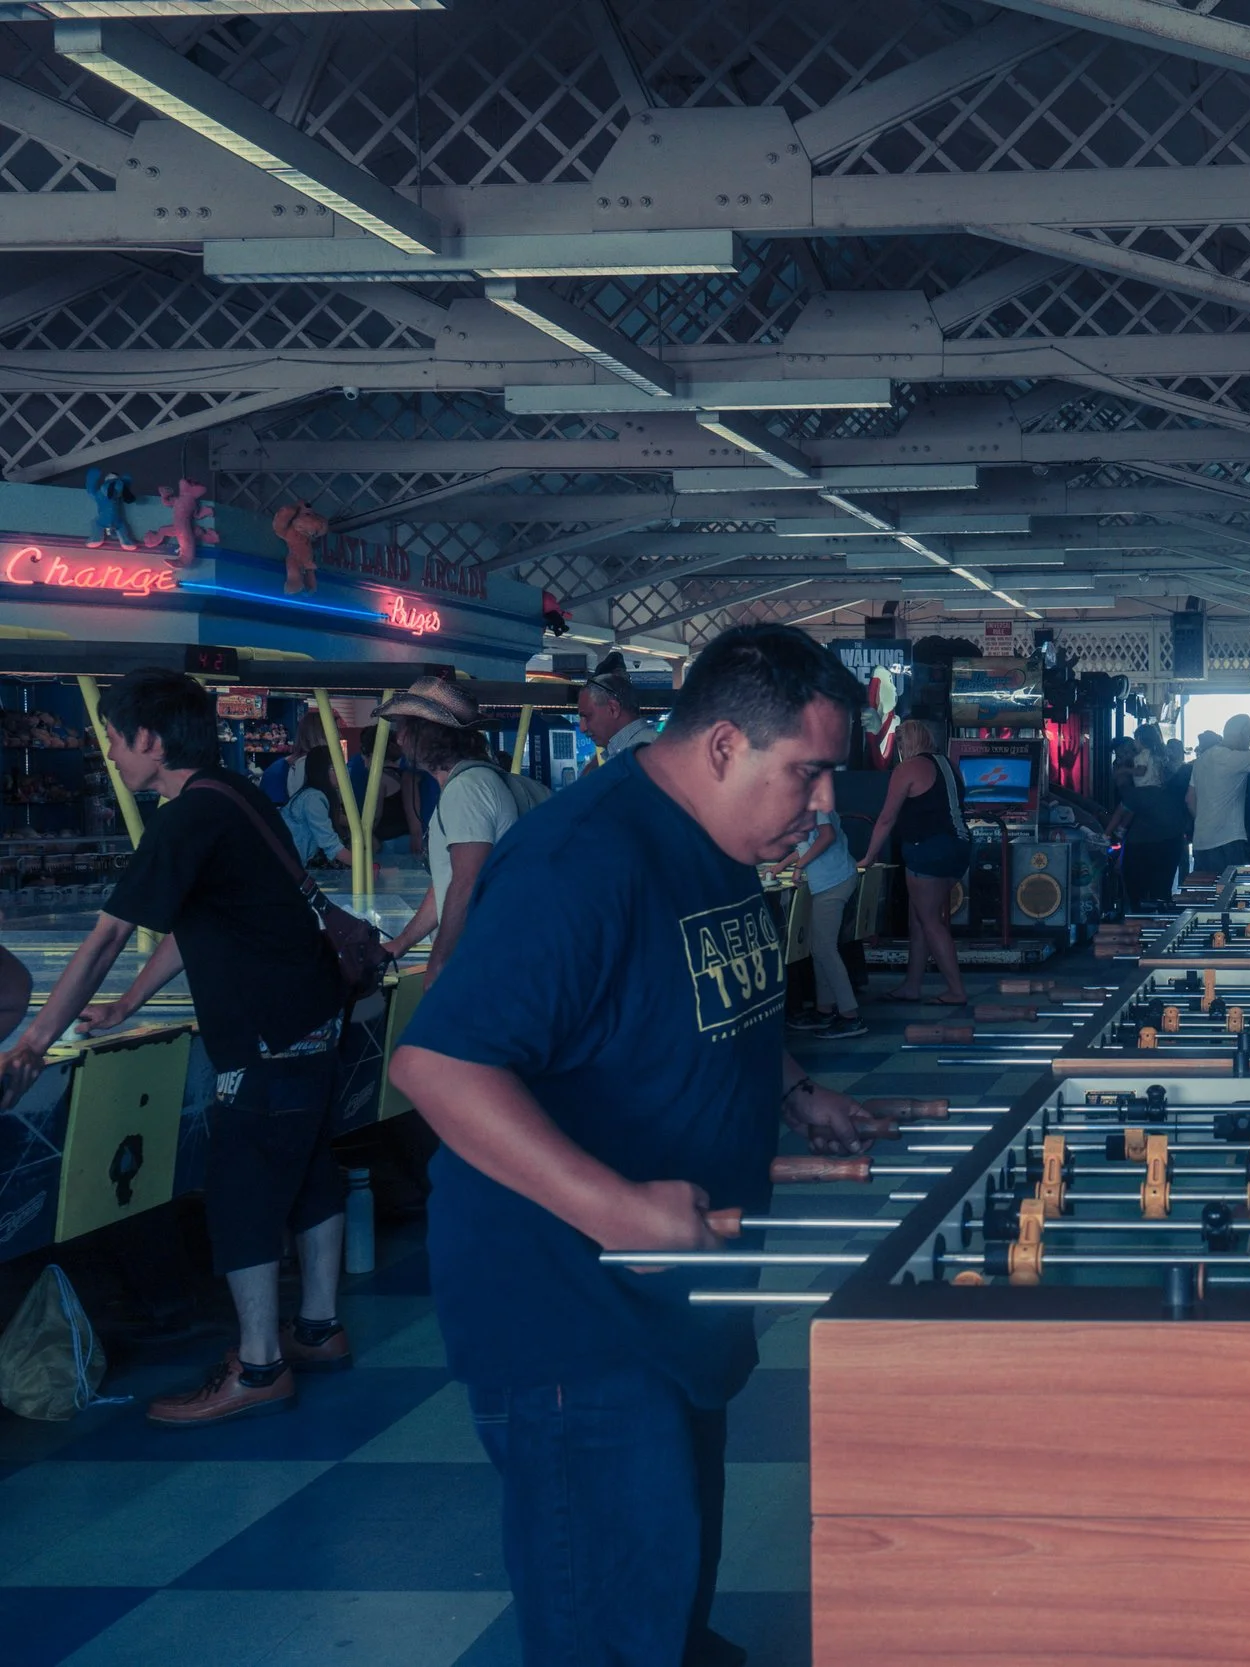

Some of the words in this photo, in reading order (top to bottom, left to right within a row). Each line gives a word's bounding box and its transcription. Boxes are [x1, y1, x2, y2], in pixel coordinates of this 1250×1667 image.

[6, 547, 178, 597] Change
[320, 532, 411, 582] LAYLAND
[420, 554, 488, 600] ARCADE
[390, 596, 440, 636] Prizes
[840, 649, 904, 667] WALKING
[699, 906, 779, 972] AERO
